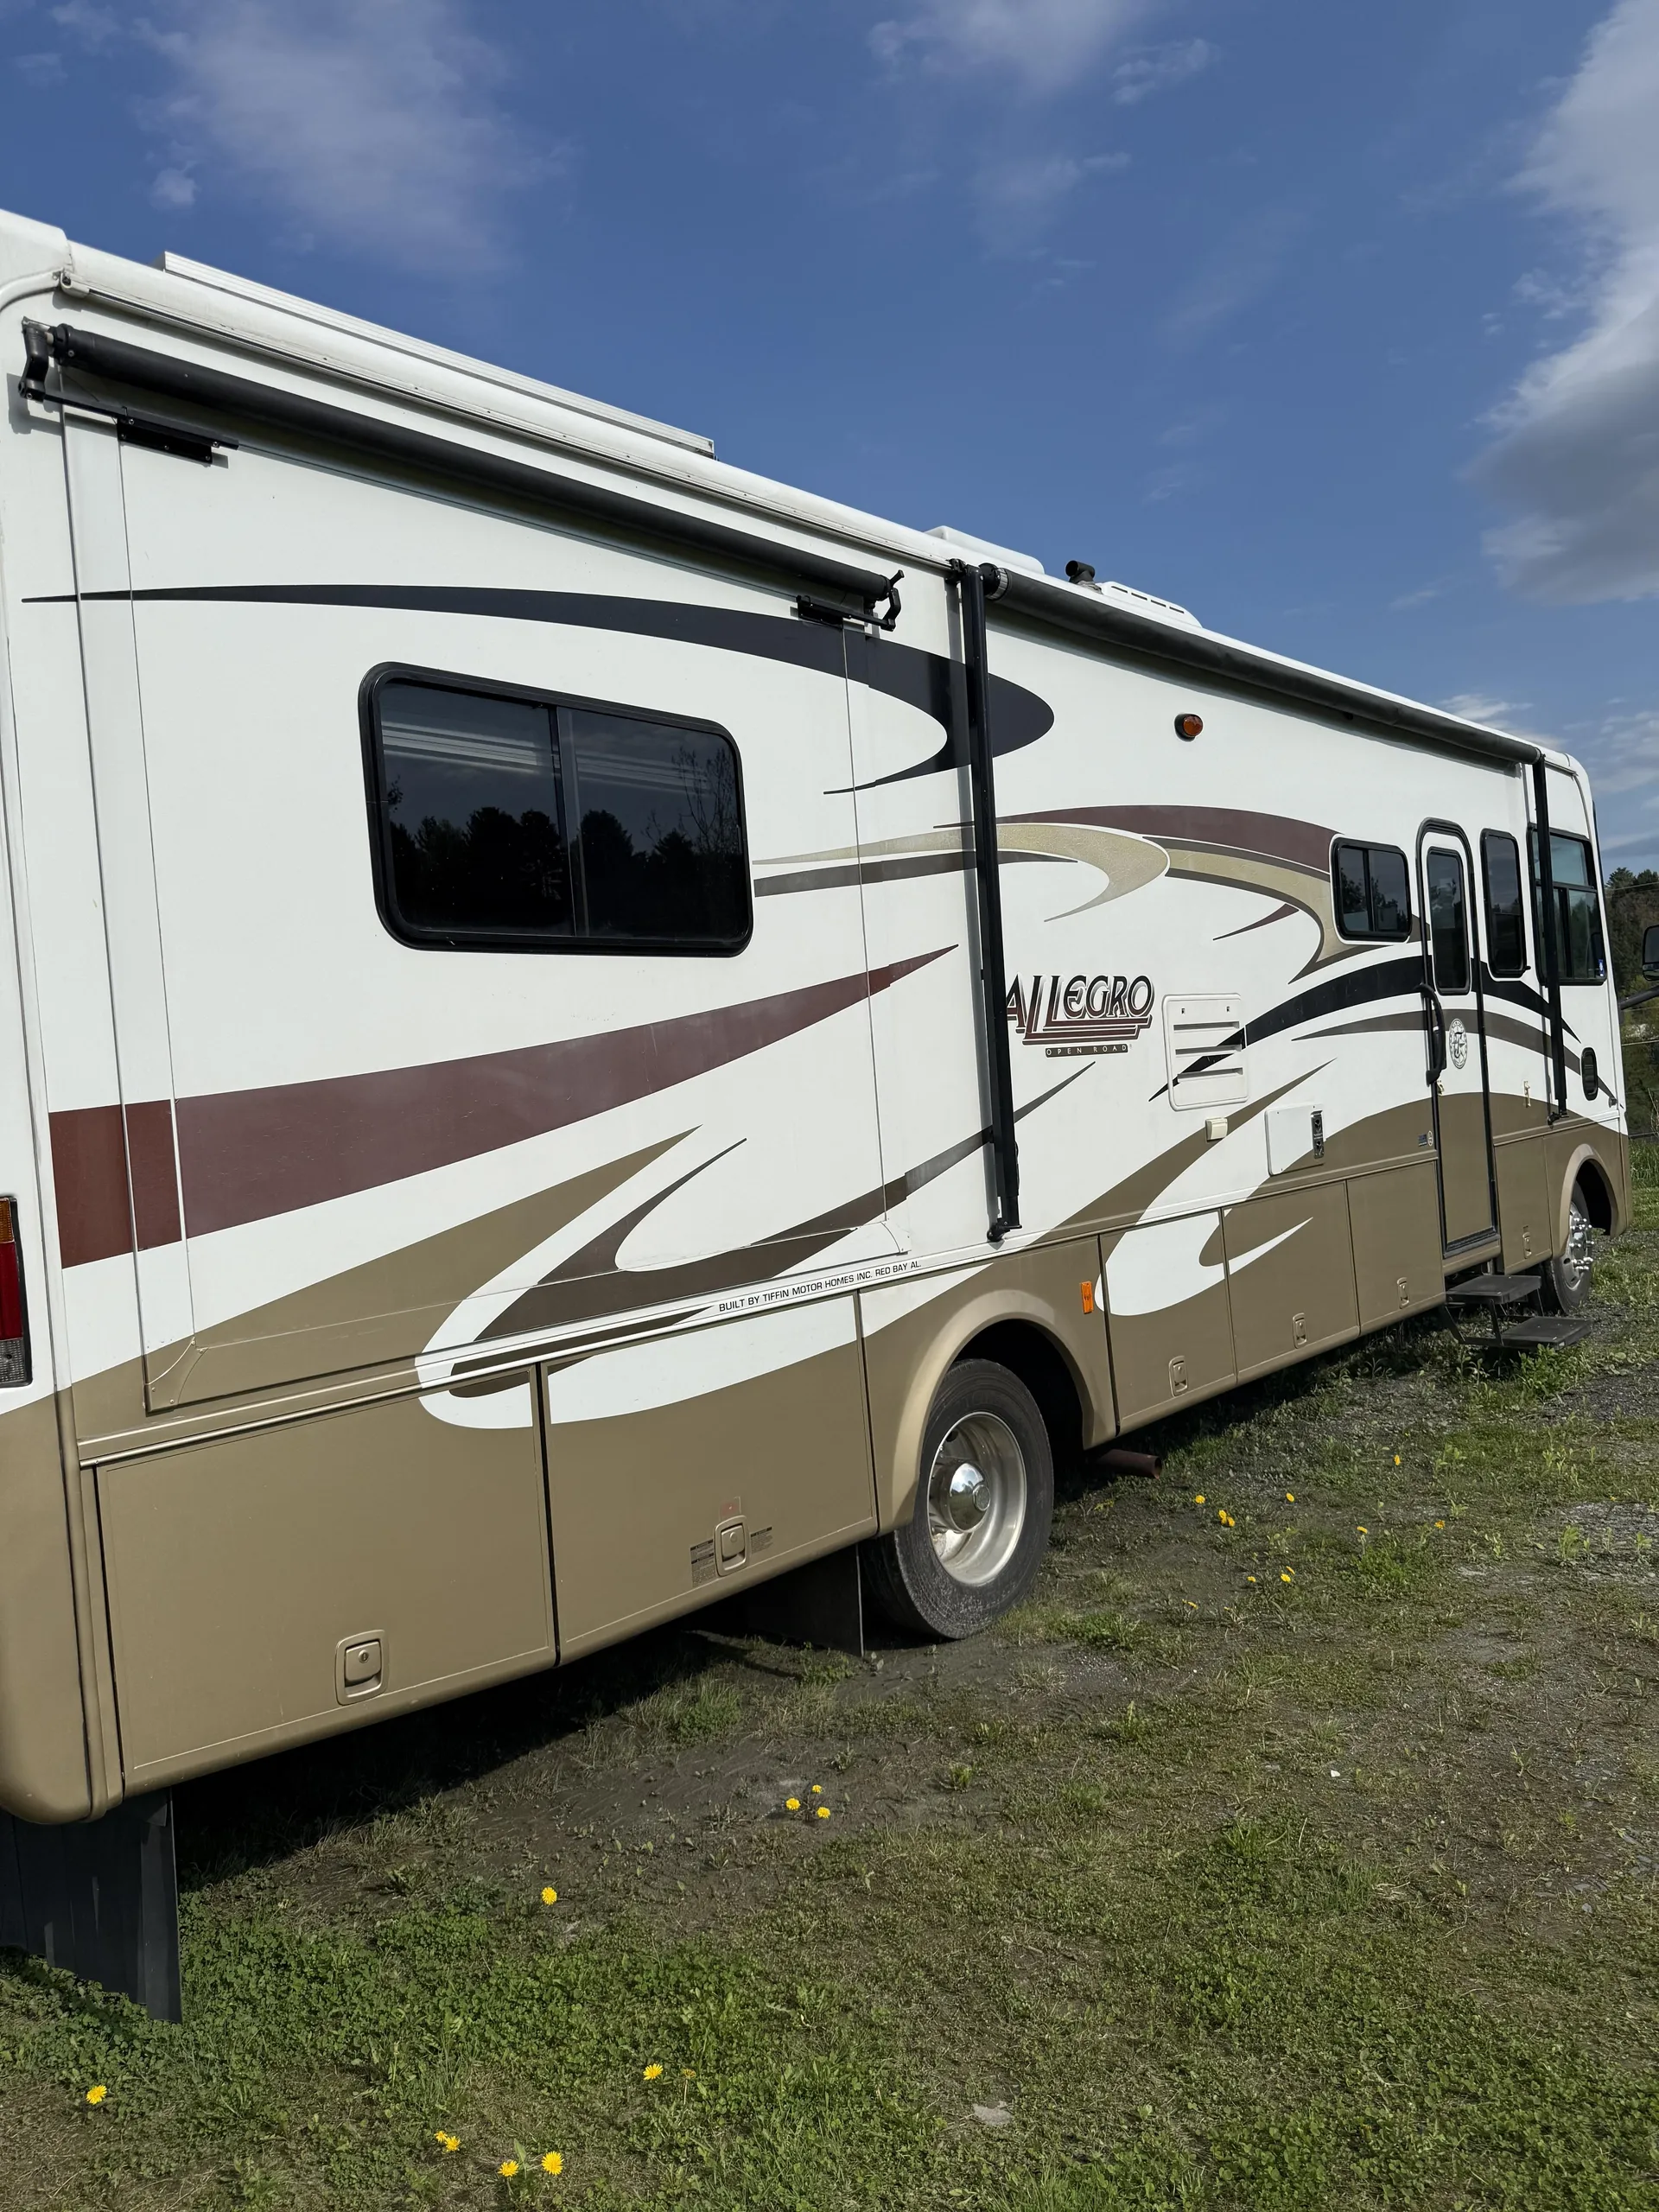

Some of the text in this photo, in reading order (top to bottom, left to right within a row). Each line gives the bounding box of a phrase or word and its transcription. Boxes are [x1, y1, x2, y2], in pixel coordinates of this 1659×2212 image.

[1006, 974, 1154, 1045] ALLEGRO
[1046, 1047, 1082, 1056] OPEN
[719, 1261, 922, 1312] BUILT BY TIFFIN MOTOR HOMES INC. RED BAY AL.
